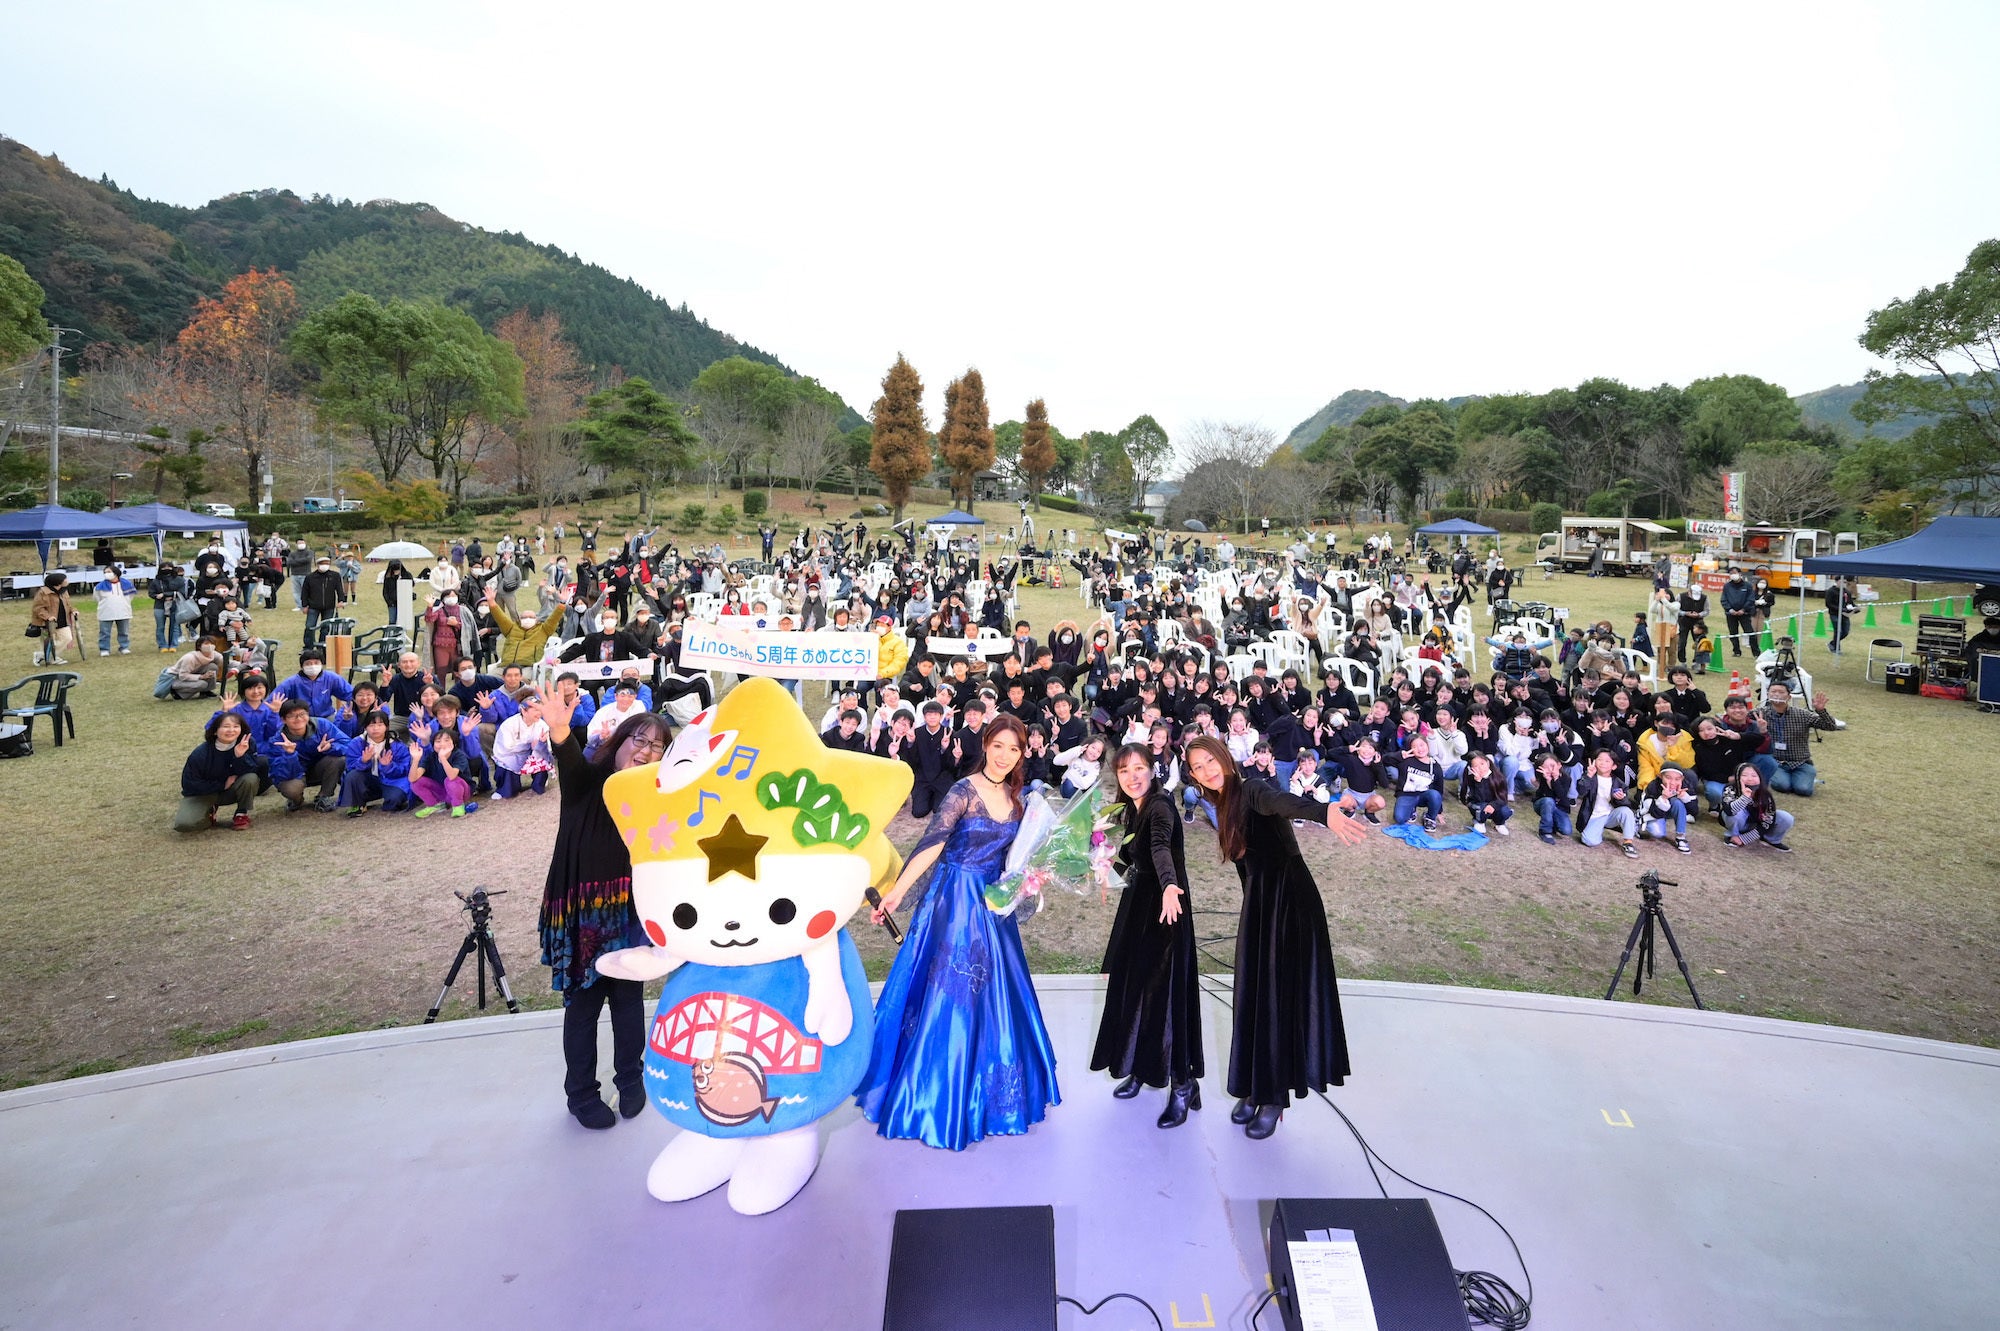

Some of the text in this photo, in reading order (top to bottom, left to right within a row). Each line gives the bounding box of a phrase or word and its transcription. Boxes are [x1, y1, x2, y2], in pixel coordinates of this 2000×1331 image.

[688, 635, 753, 661] Linoちゃん
[756, 645, 798, 665] 5周年
